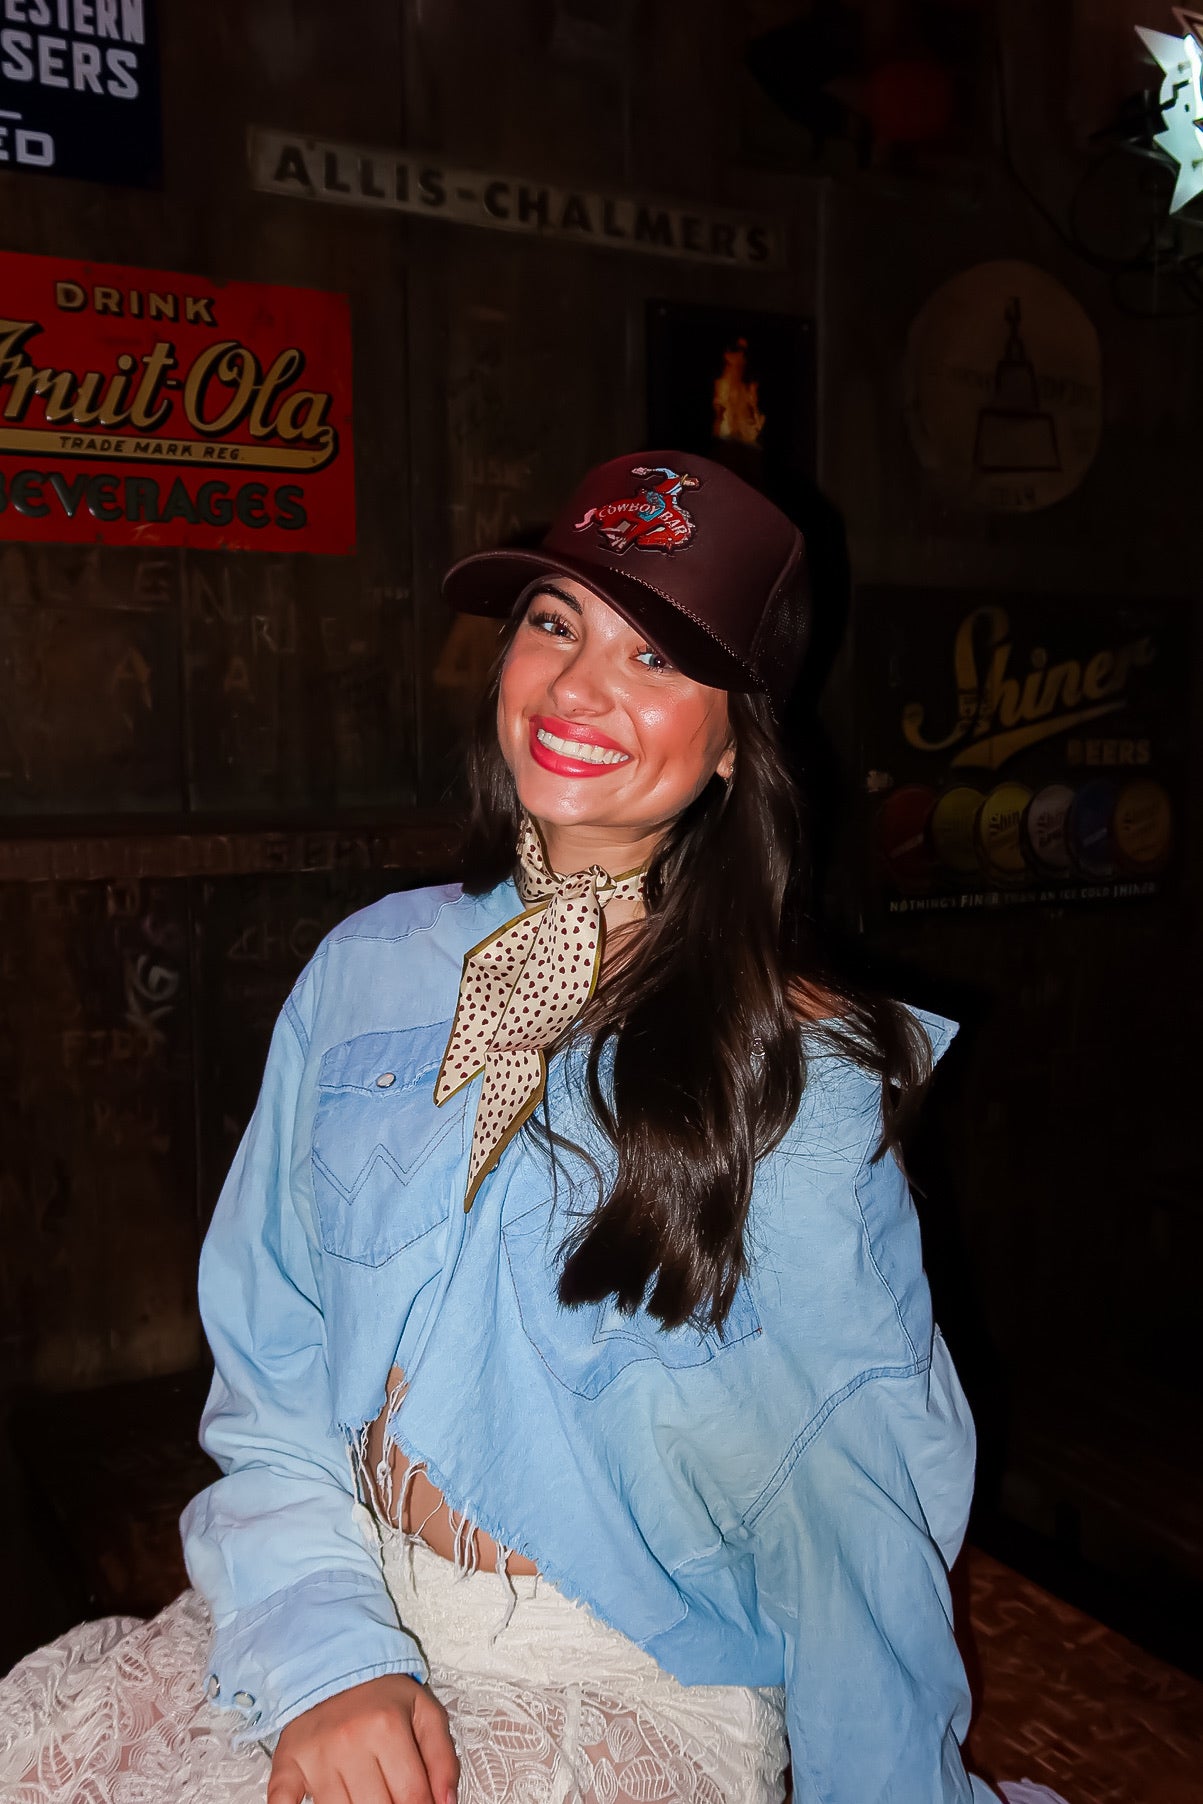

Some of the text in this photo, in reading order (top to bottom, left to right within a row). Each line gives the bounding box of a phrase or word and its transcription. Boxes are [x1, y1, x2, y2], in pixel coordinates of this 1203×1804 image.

[0, 28, 140, 100] SERS
[0, 125, 56, 168] D
[273, 145, 769, 262] ALLIS-CHALMERS
[55, 281, 216, 326] DRINK
[59, 435, 124, 453] TRADE
[133, 441, 193, 457] MARK
[0, 471, 307, 529] EVERAGES
[599, 502, 688, 537] COWBOY BAR
[901, 605, 1157, 752] Shiner
[1066, 737, 1152, 767] BEERS
